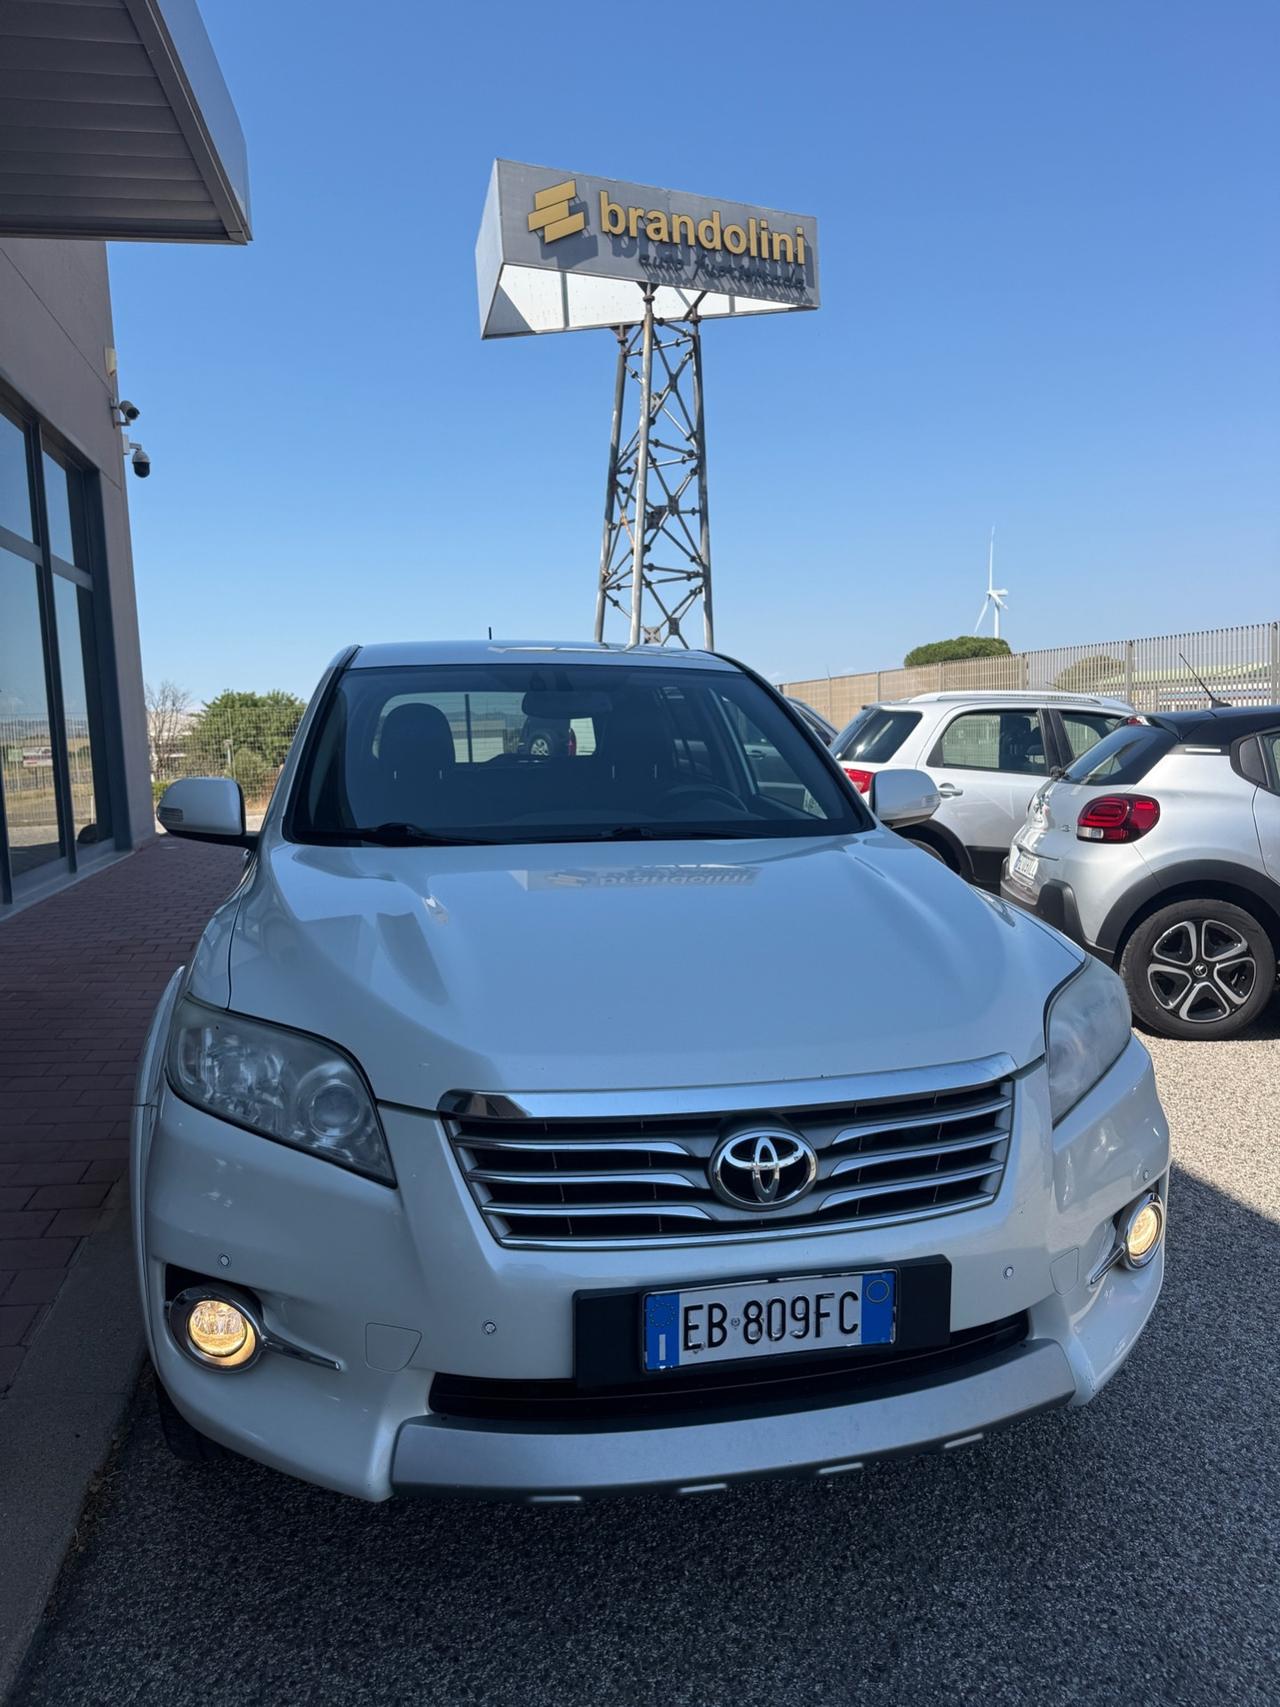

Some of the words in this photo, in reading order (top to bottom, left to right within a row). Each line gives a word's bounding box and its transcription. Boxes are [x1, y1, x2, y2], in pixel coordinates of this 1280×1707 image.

[600, 190, 805, 265] brandolini
[683, 1303, 728, 1351] EB
[743, 1291, 859, 1345] 809FC
